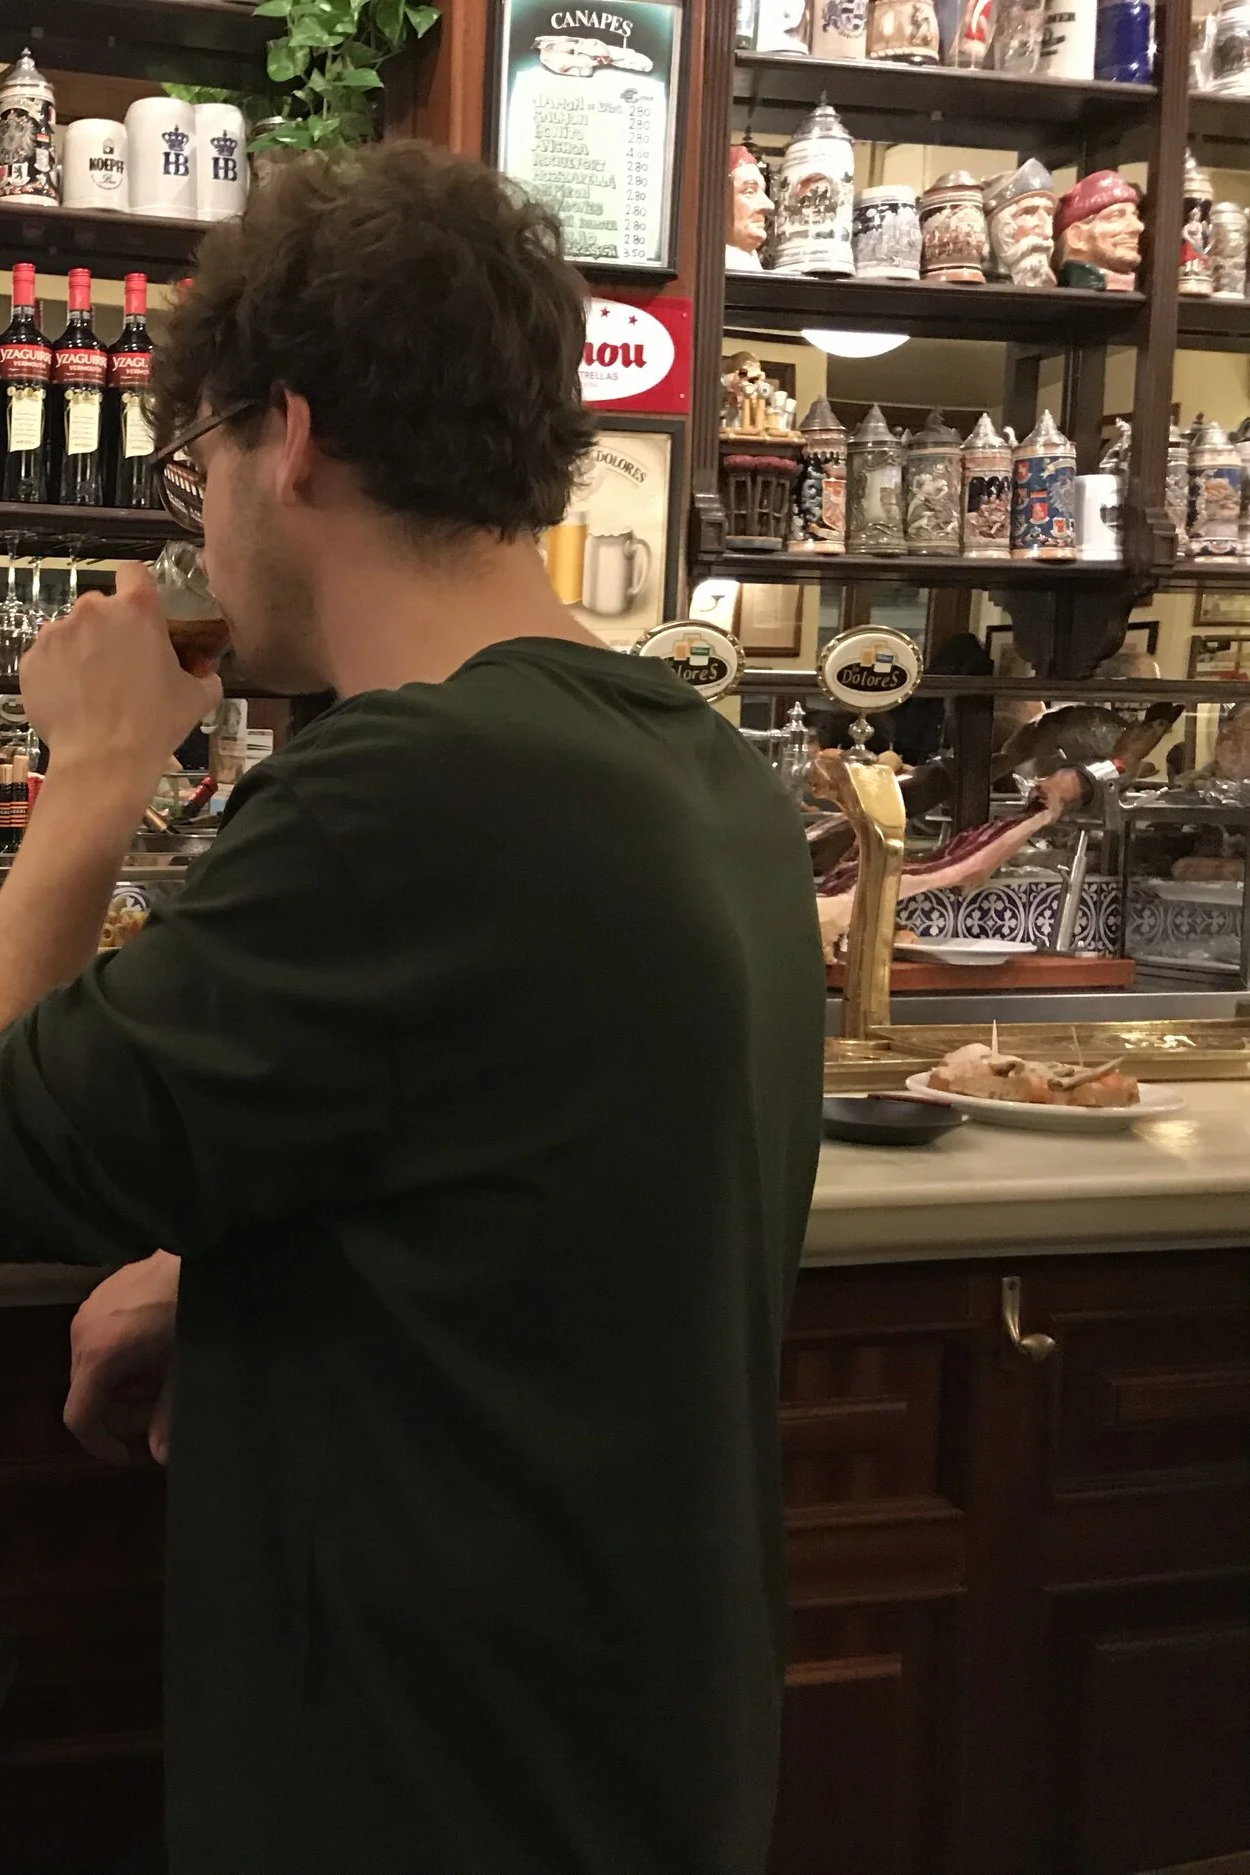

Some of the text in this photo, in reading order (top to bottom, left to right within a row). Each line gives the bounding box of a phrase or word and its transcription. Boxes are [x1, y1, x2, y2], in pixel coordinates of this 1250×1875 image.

[550, 10, 634, 37] CANAPES
[162, 151, 190, 177] HB
[211, 156, 238, 182] HB
[579, 370, 619, 381] TRELLAS
[595, 449, 648, 484] DOLORES
